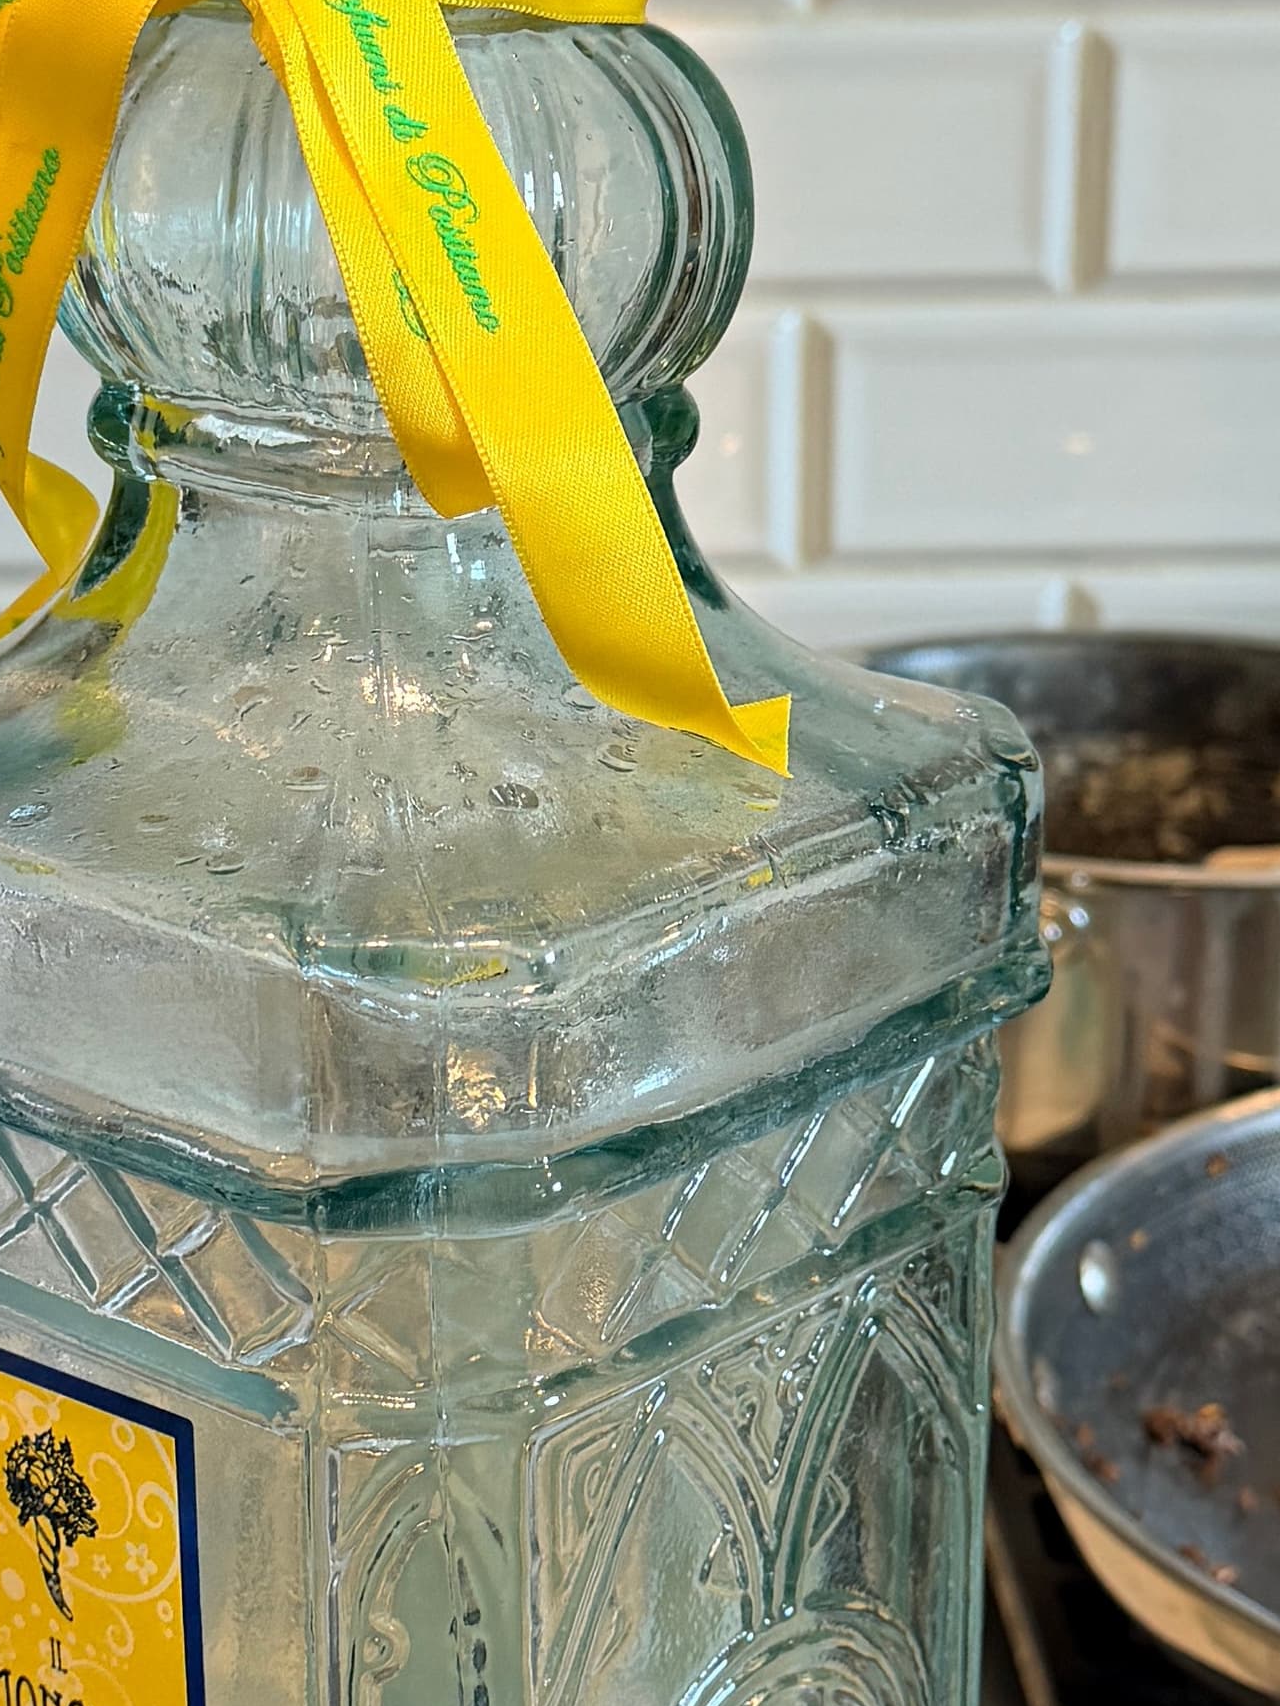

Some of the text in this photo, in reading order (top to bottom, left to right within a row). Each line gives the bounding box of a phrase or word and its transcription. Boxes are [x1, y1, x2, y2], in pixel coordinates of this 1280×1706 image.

[383, 104, 430, 143] di
[406, 152, 501, 336] Positano
[49, 1637, 67, 1674] IL
